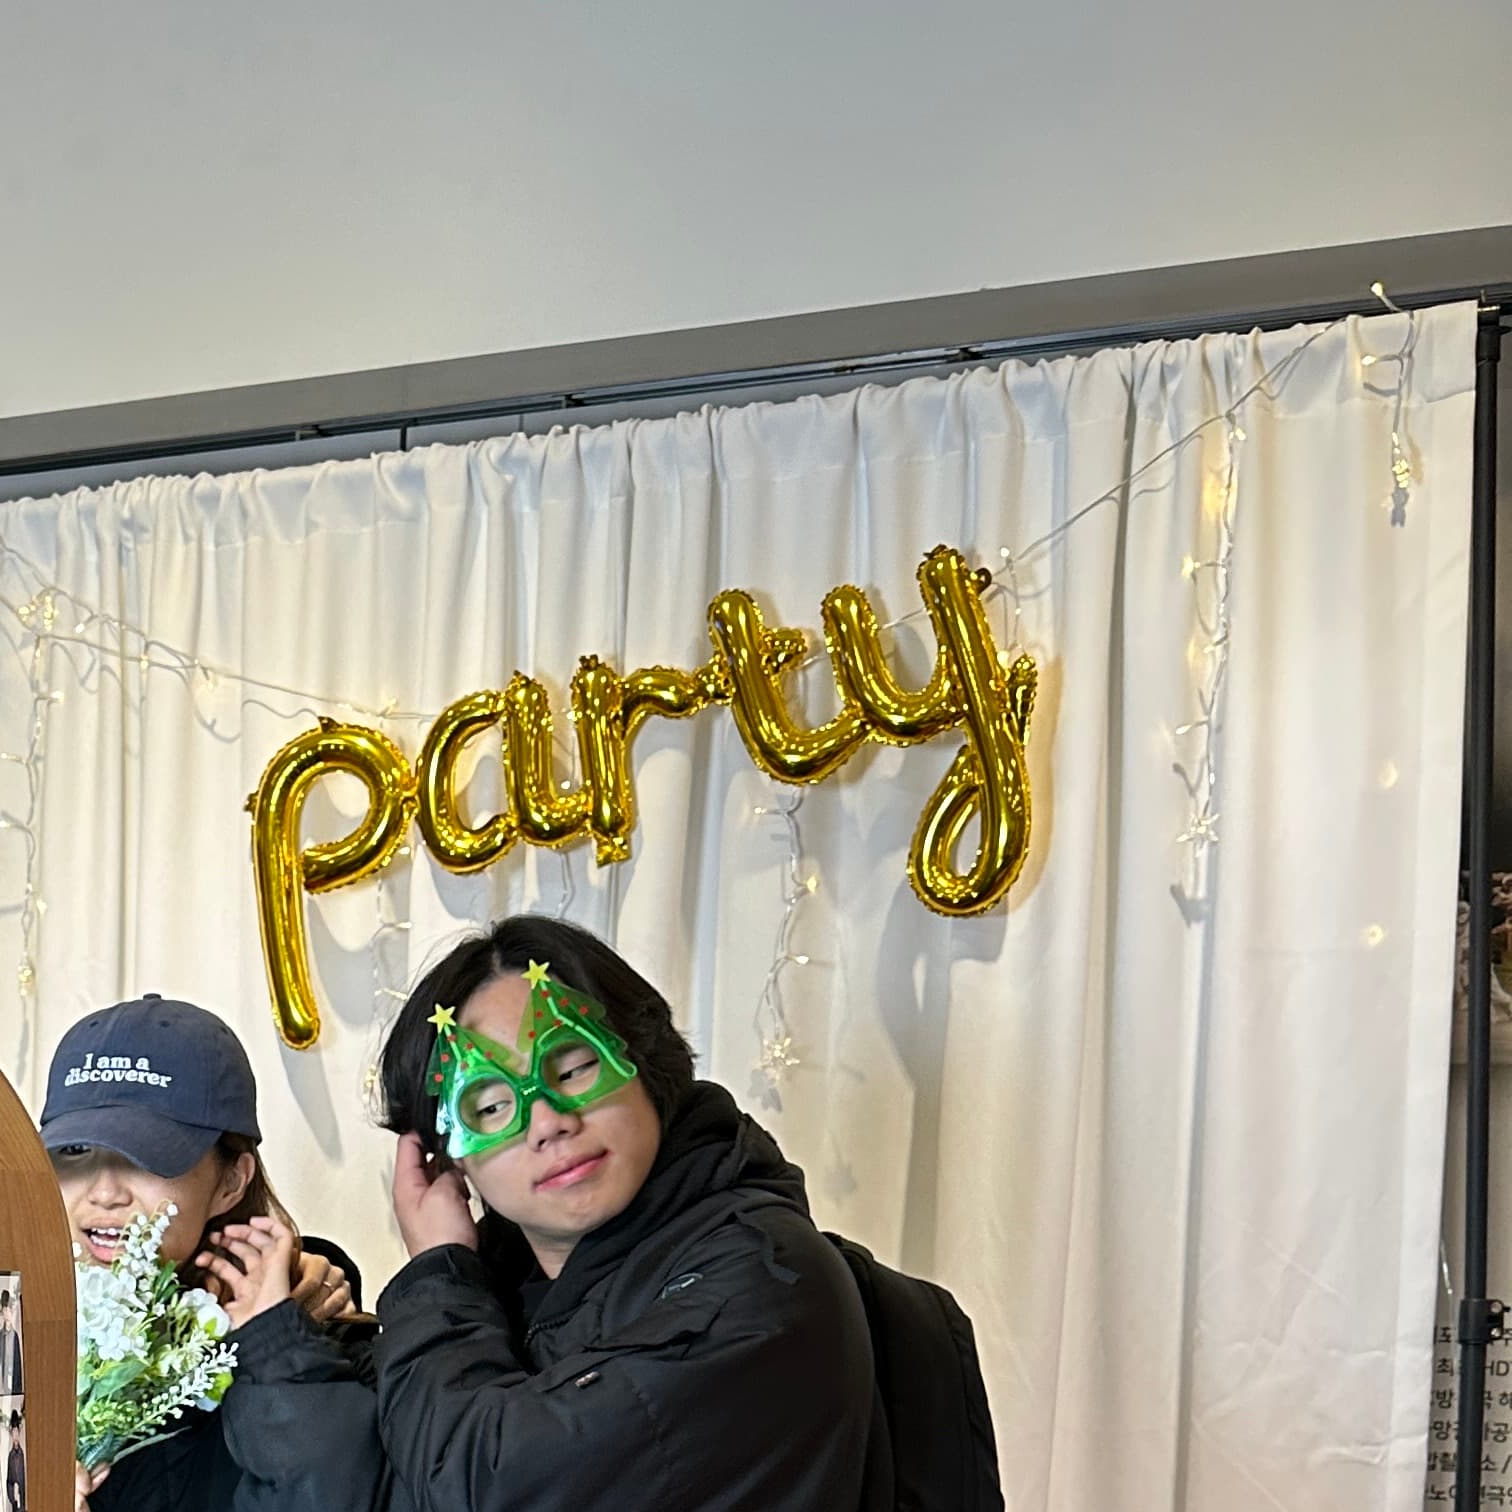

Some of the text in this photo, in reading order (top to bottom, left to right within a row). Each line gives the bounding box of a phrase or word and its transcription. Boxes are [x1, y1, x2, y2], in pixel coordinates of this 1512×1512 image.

[245, 545, 1038, 1050] party
[96, 1055, 131, 1070] am
[135, 1057, 150, 1071] a
[64, 1068, 172, 1088] discoverer
